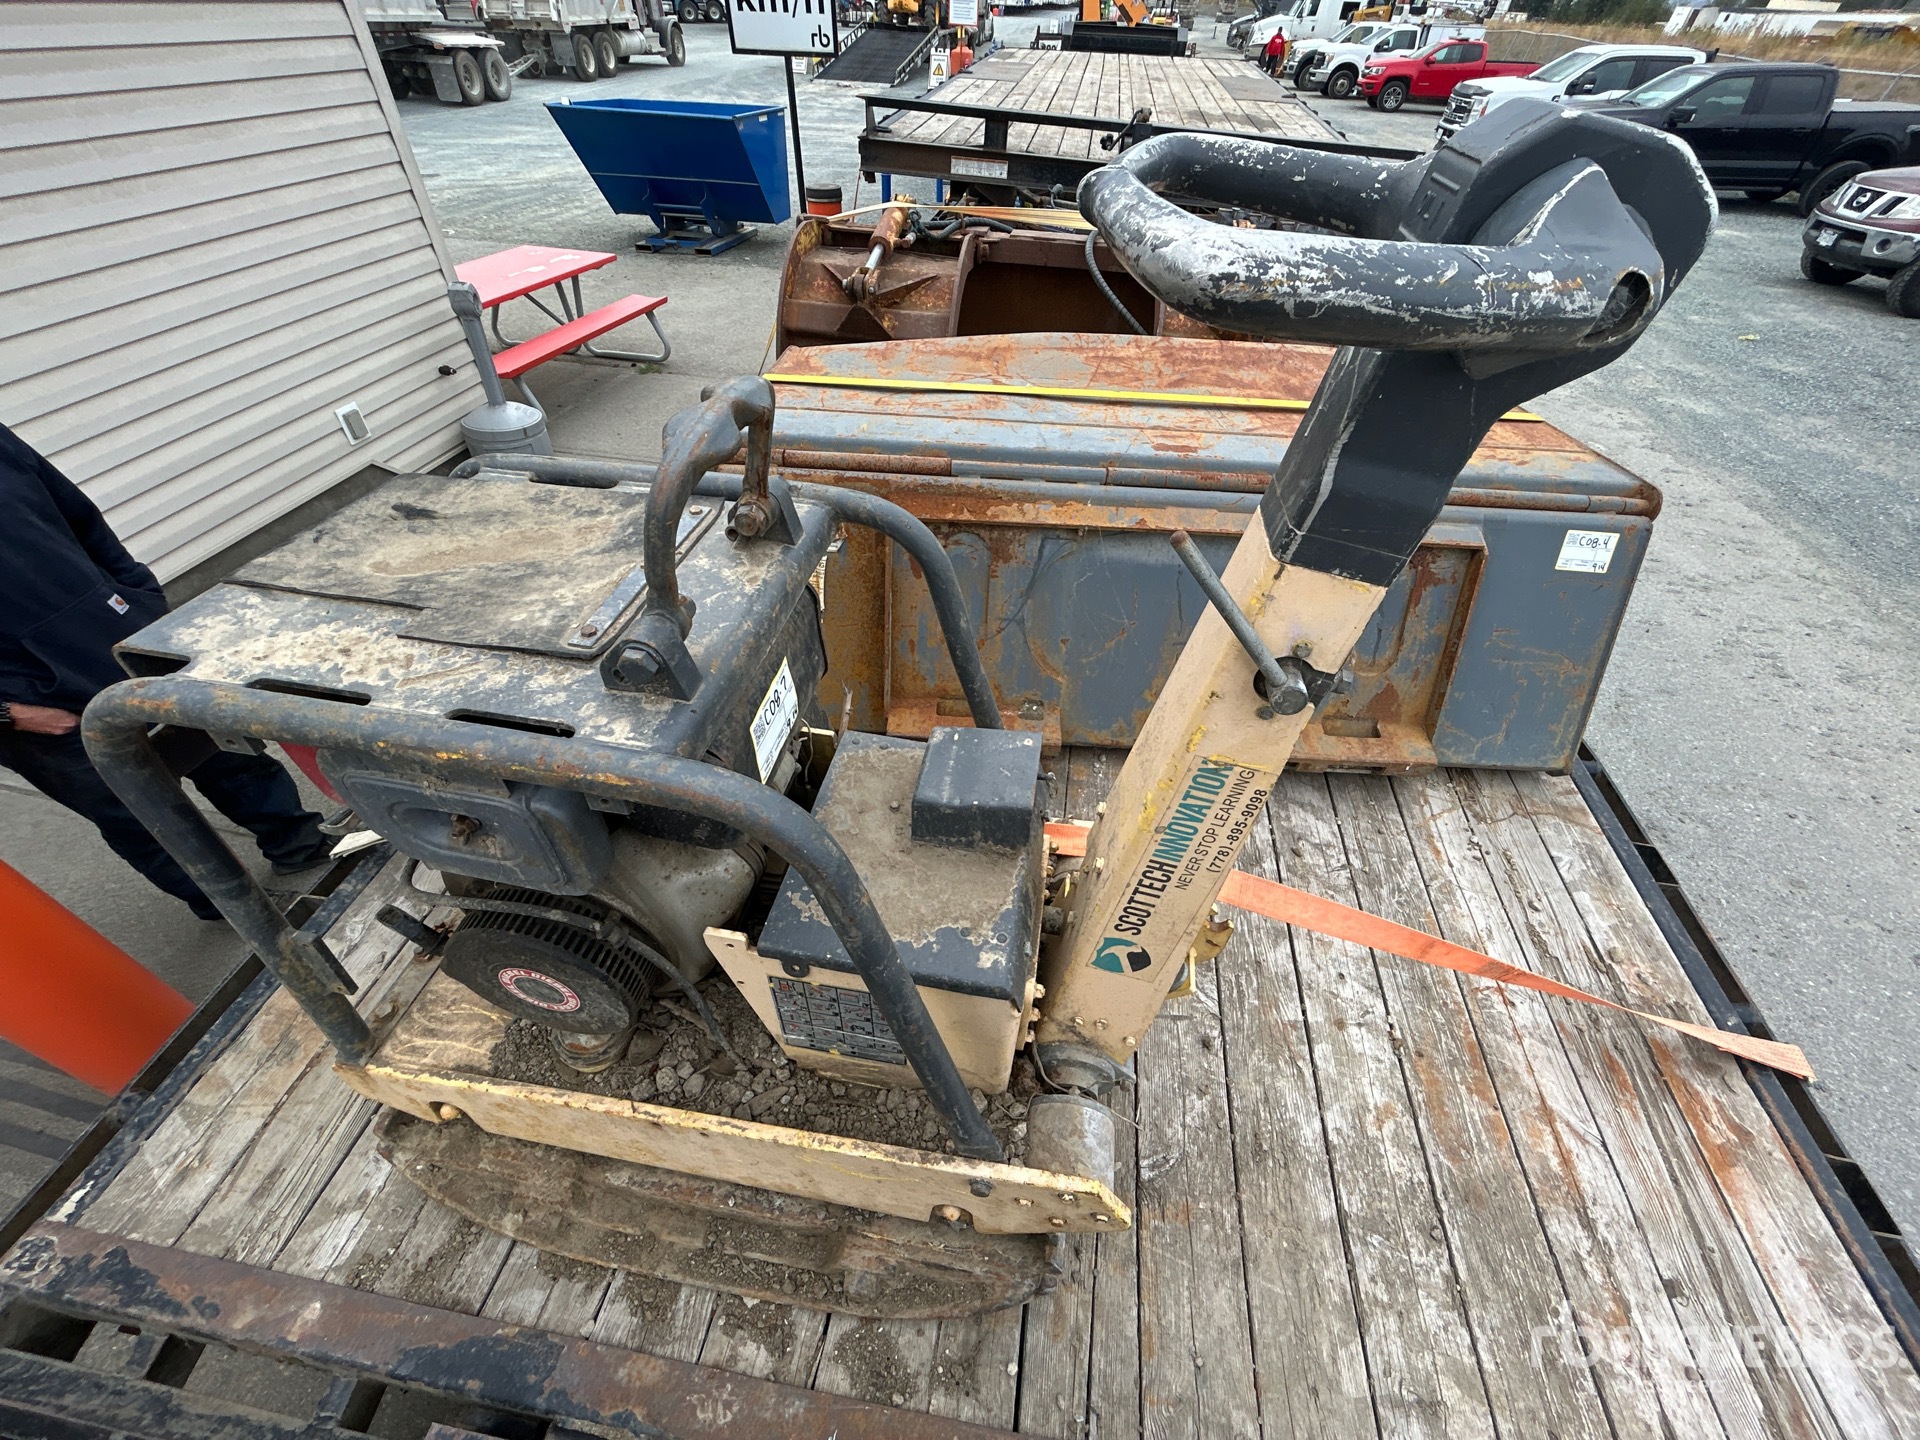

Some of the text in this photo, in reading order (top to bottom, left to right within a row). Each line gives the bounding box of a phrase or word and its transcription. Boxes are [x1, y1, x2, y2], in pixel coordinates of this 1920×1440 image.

[811, 24, 830, 48] rb
[1175, 769, 1255, 890] NEVER STOP LEARNING
